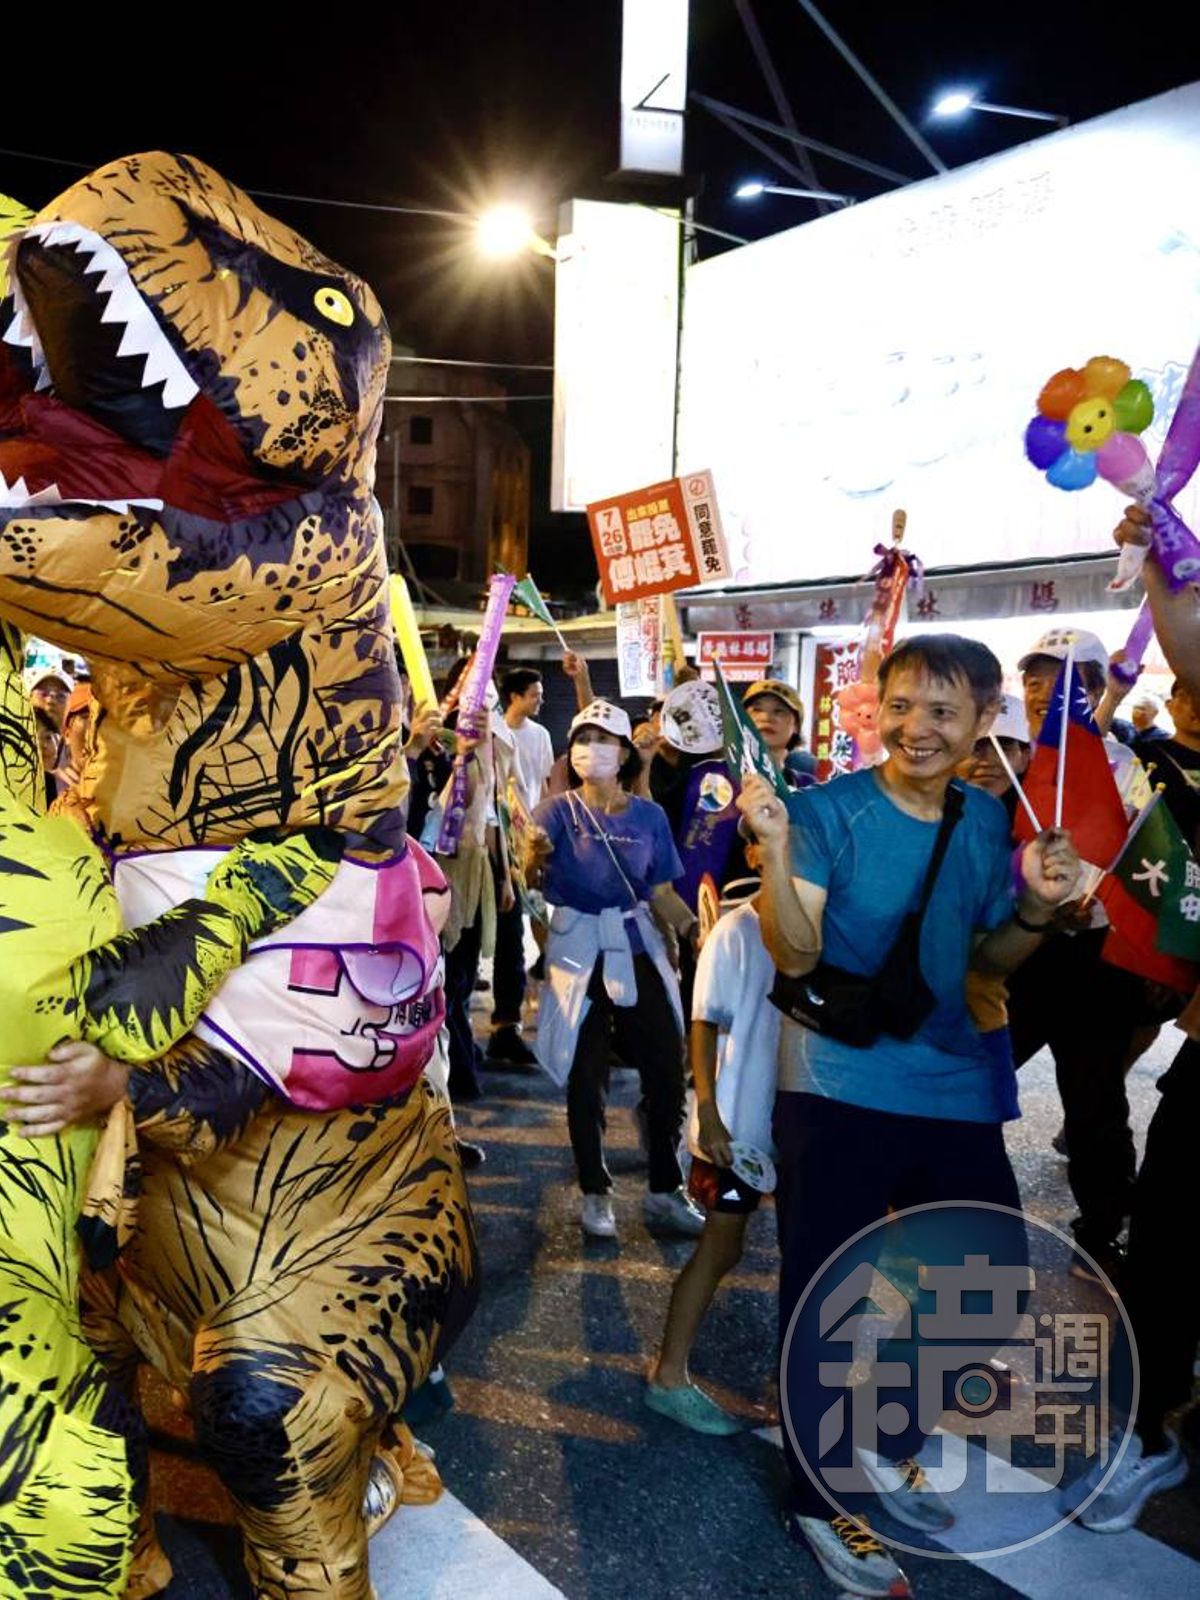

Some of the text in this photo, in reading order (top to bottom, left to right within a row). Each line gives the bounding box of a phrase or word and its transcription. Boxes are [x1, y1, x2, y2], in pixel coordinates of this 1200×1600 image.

[602, 529, 623, 547] 26
[627, 512, 682, 551] 罷免
[693, 503, 722, 573] 同意罷免
